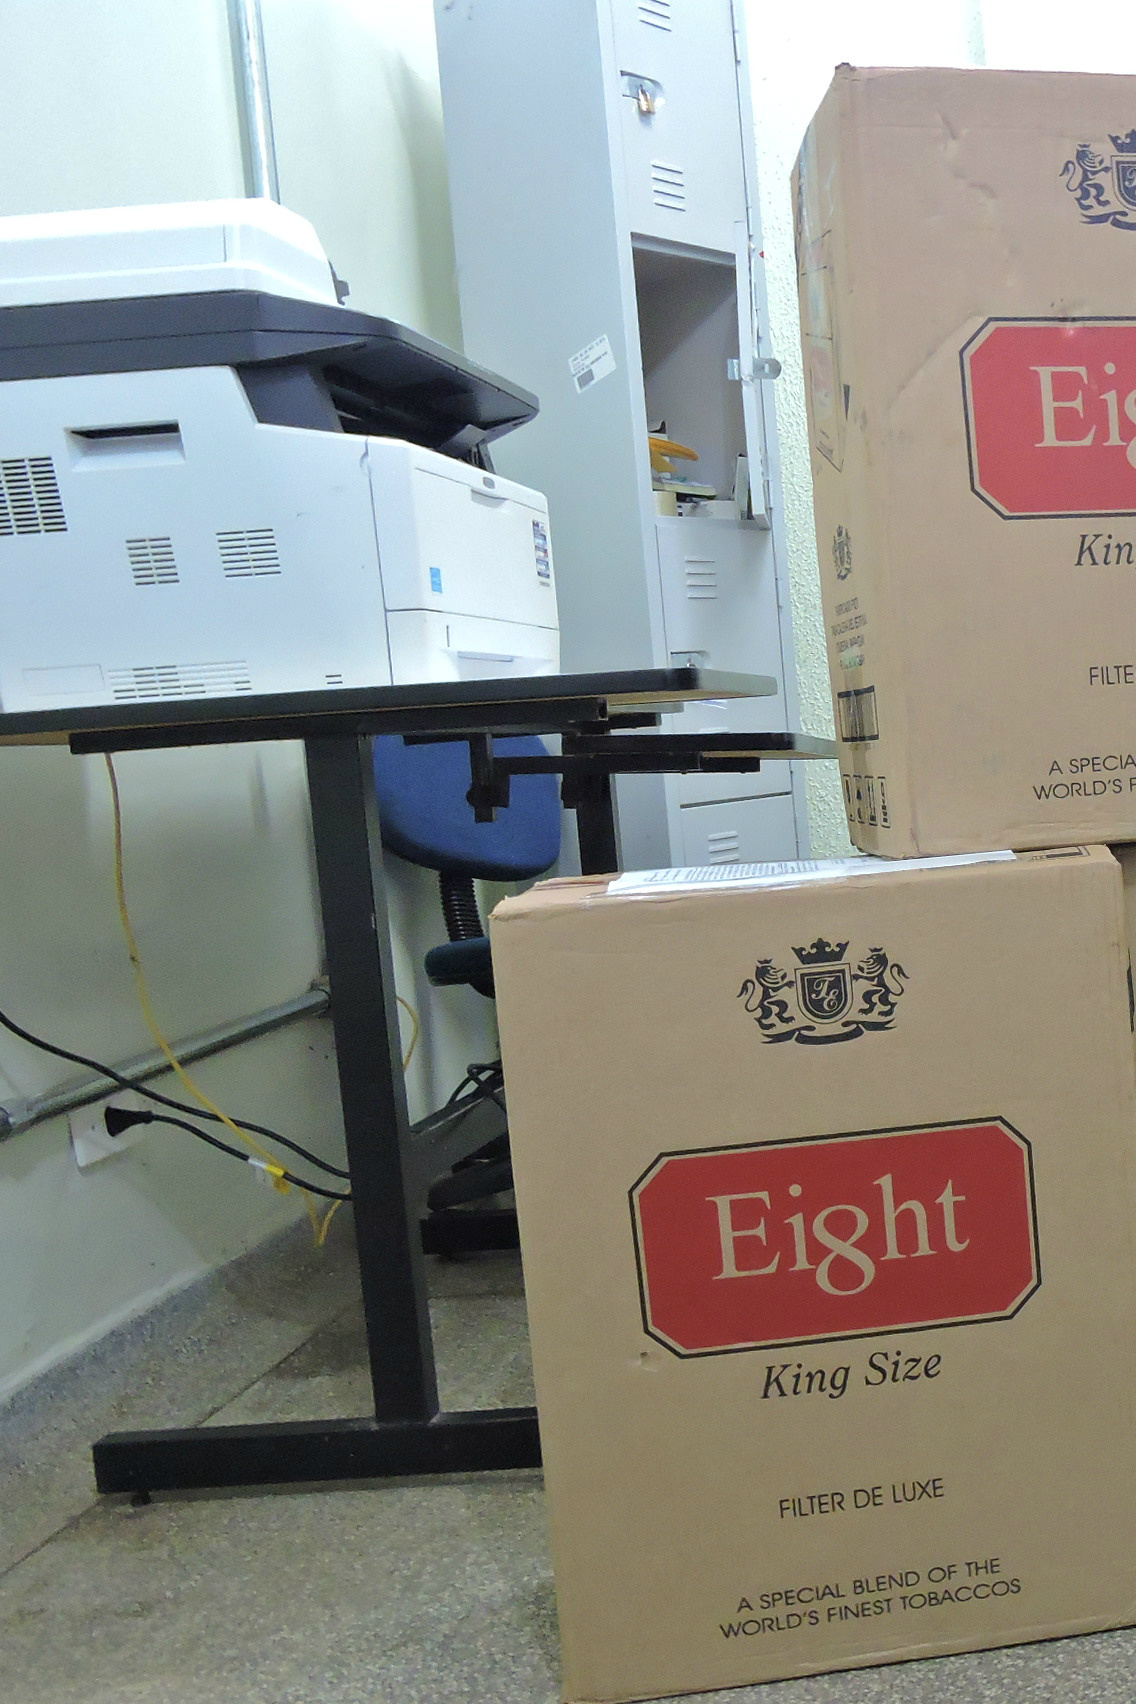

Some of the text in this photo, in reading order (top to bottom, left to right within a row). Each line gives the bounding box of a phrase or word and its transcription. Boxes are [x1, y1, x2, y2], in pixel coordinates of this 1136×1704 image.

[1032, 778, 1123, 801] WORLD'S
[1048, 759, 1064, 777] A
[759, 1349, 942, 1400] King Size
[778, 1477, 945, 1519] FILTER DE LUXE
[718, 1577, 1022, 1640] WORLD'S FINEST TOBACCOS
[736, 1557, 1001, 1614] A SPECIAL BLEND OF THE
